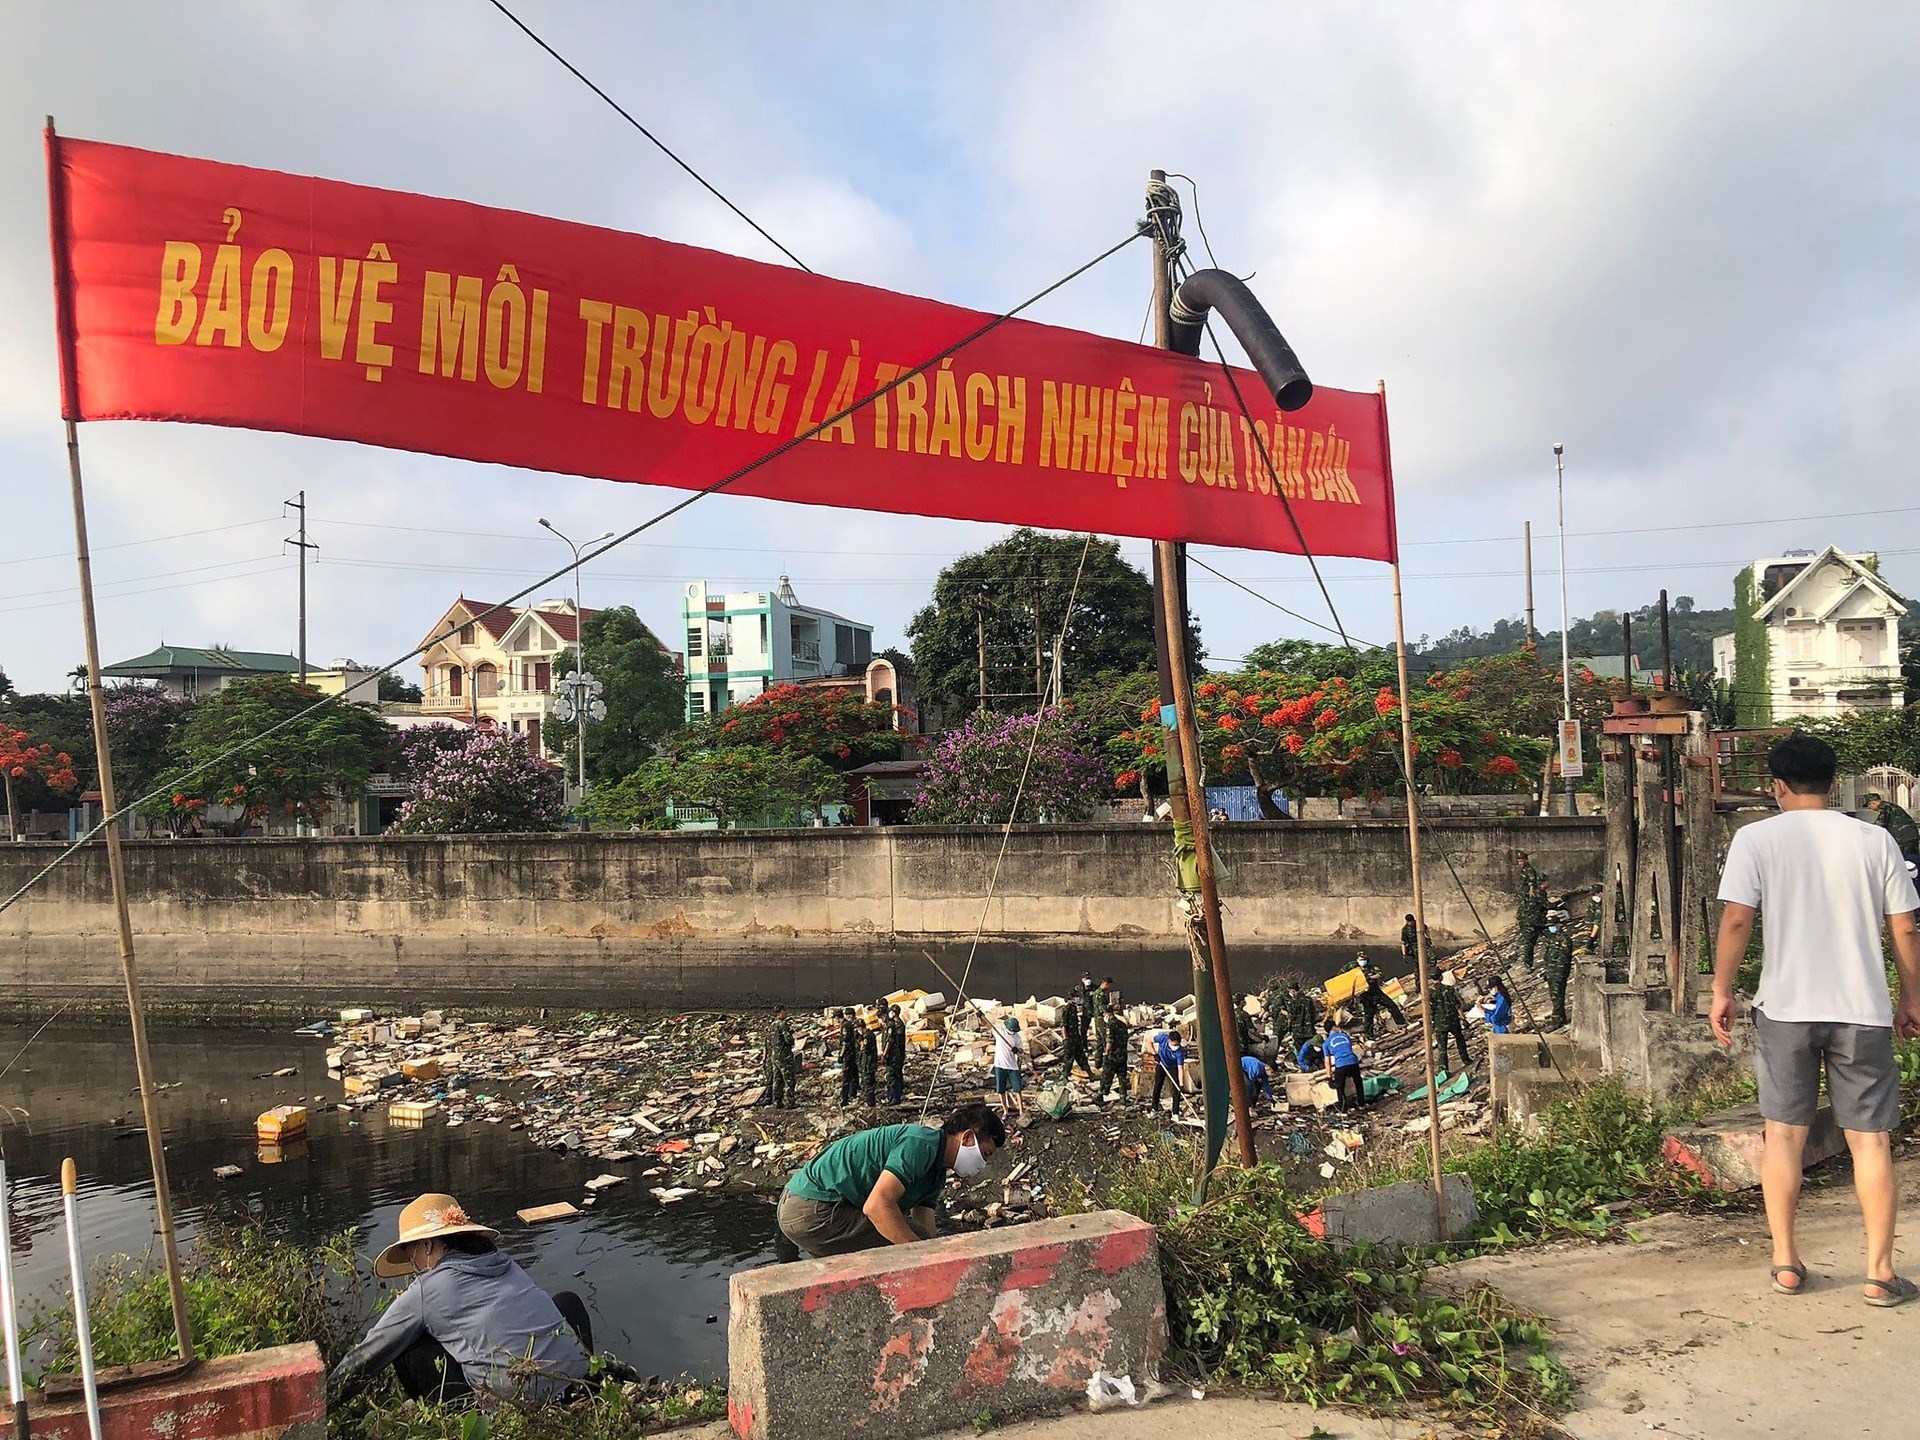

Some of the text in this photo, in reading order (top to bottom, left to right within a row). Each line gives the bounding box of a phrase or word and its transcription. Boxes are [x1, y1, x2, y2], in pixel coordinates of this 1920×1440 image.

[154, 207, 1362, 505] BẢO VỆ MÔI TRƯỜNG LÀ TRÁCH NHIỆM CỦA TOÀN DÂN
